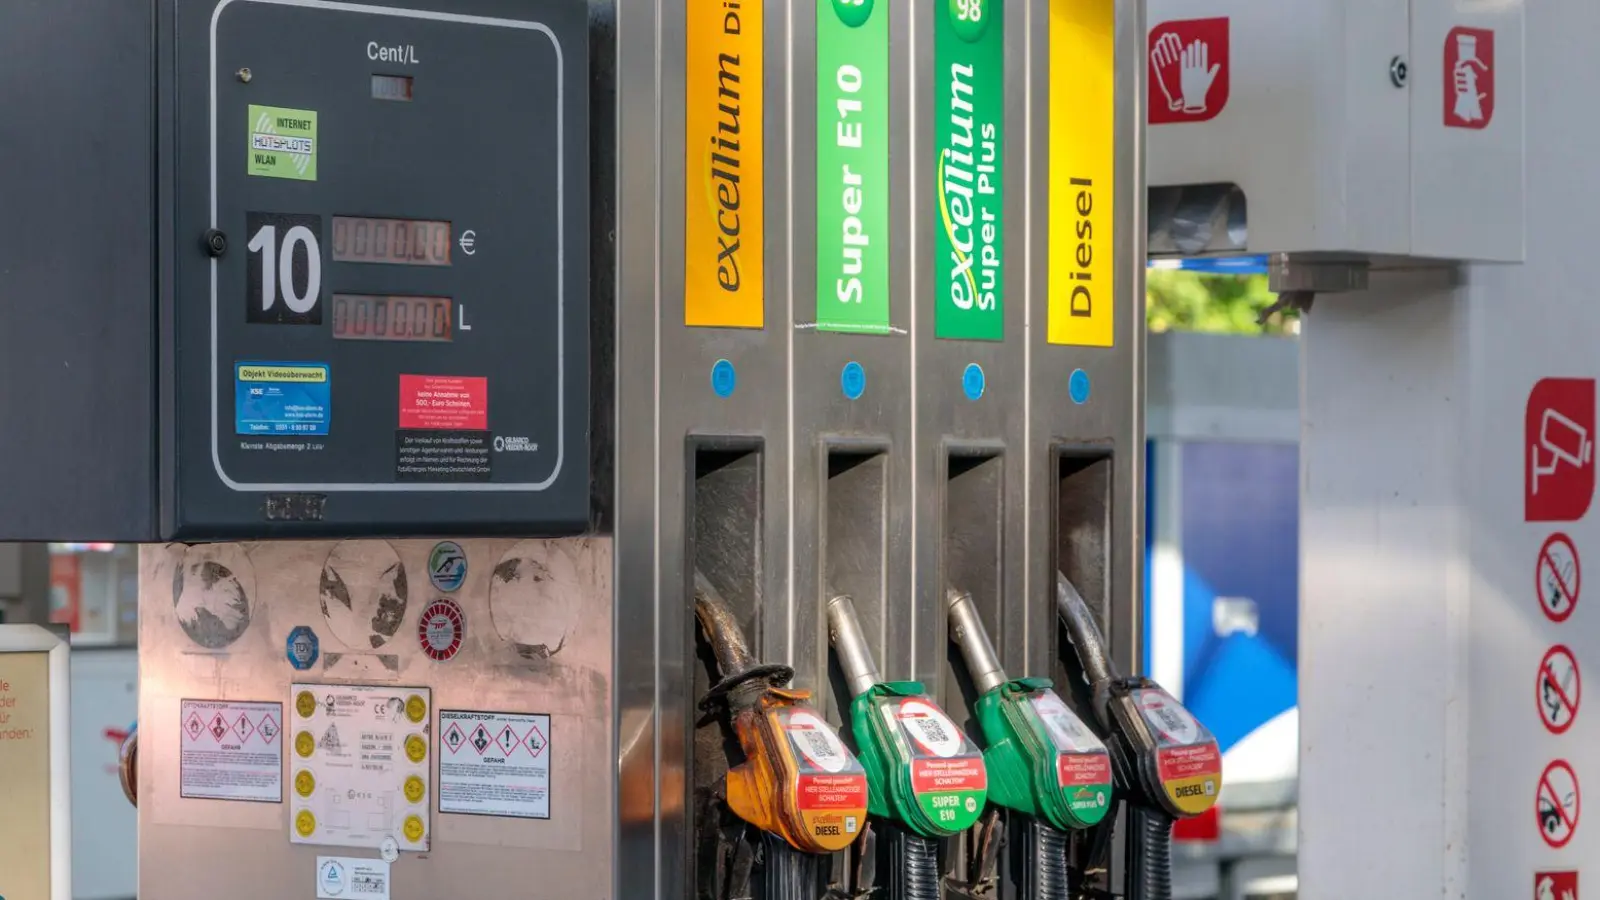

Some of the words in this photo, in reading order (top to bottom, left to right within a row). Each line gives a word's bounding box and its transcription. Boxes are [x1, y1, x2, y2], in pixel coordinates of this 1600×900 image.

[367, 41, 420, 65] Cent/L
[837, 64, 863, 148] E10
[277, 118, 312, 130] INTERNET
[255, 154, 276, 166] WLAN
[977, 122, 995, 194] Plus
[711, 53, 741, 292] excellium
[943, 63, 974, 310] excellium
[837, 164, 869, 303] Super
[977, 207, 1000, 311] Super
[1070, 177, 1093, 317] Diesel
[247, 225, 322, 313] 10
[459, 304, 471, 330] L
[243, 370, 266, 379] Objekt
[441, 713, 495, 721] DIESELKRAFTSTOFF
[932, 796, 960, 808] SUPER
[1175, 784, 1203, 798] DIESEL
[940, 809, 956, 821] E10
[815, 826, 840, 836] DIESEL
